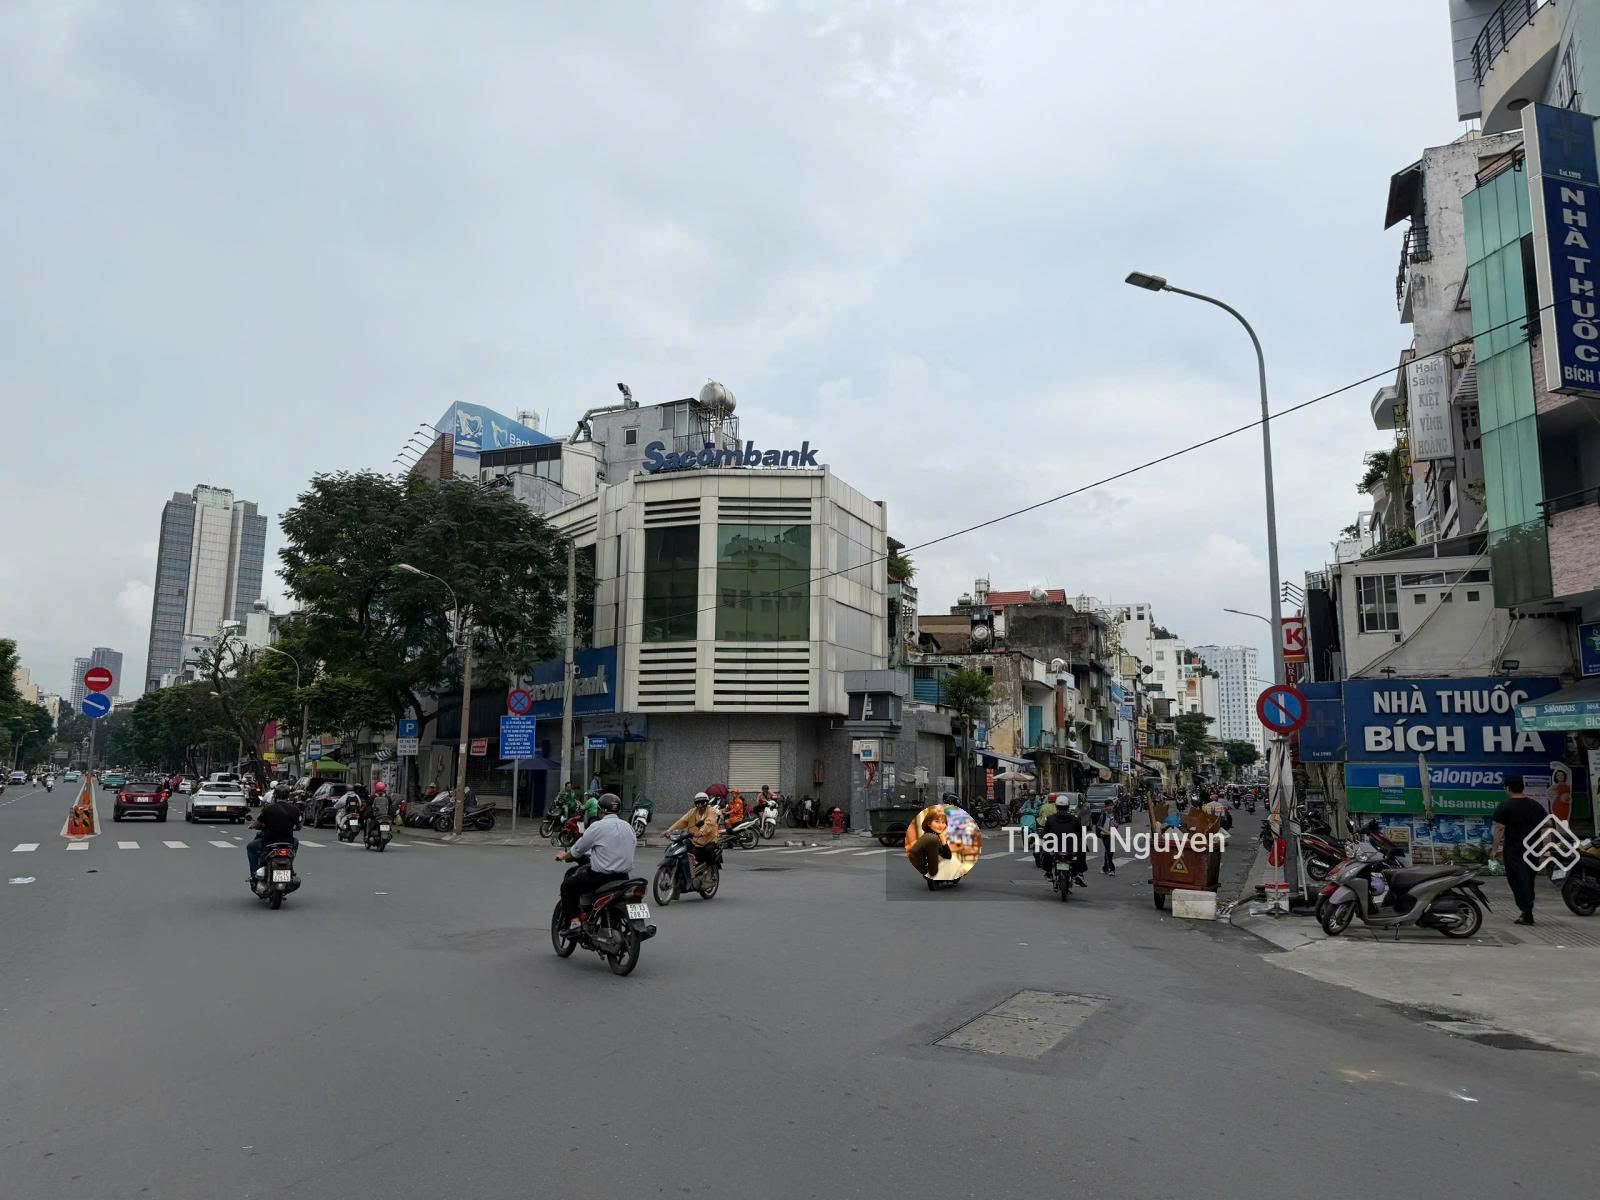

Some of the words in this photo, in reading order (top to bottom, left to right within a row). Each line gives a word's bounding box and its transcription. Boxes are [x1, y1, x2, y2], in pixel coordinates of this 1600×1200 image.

[1412, 375, 1443, 386] Salon
[1564, 365, 1595, 383] BÍCH
[642, 440, 820, 475] Sacombank
[1373, 684, 1427, 714] NHÀ
[1436, 680, 1529, 714] THUỐC
[1543, 703, 1576, 714] Salonpas
[405, 723, 415, 733] P
[1364, 718, 1466, 753] BÍCH
